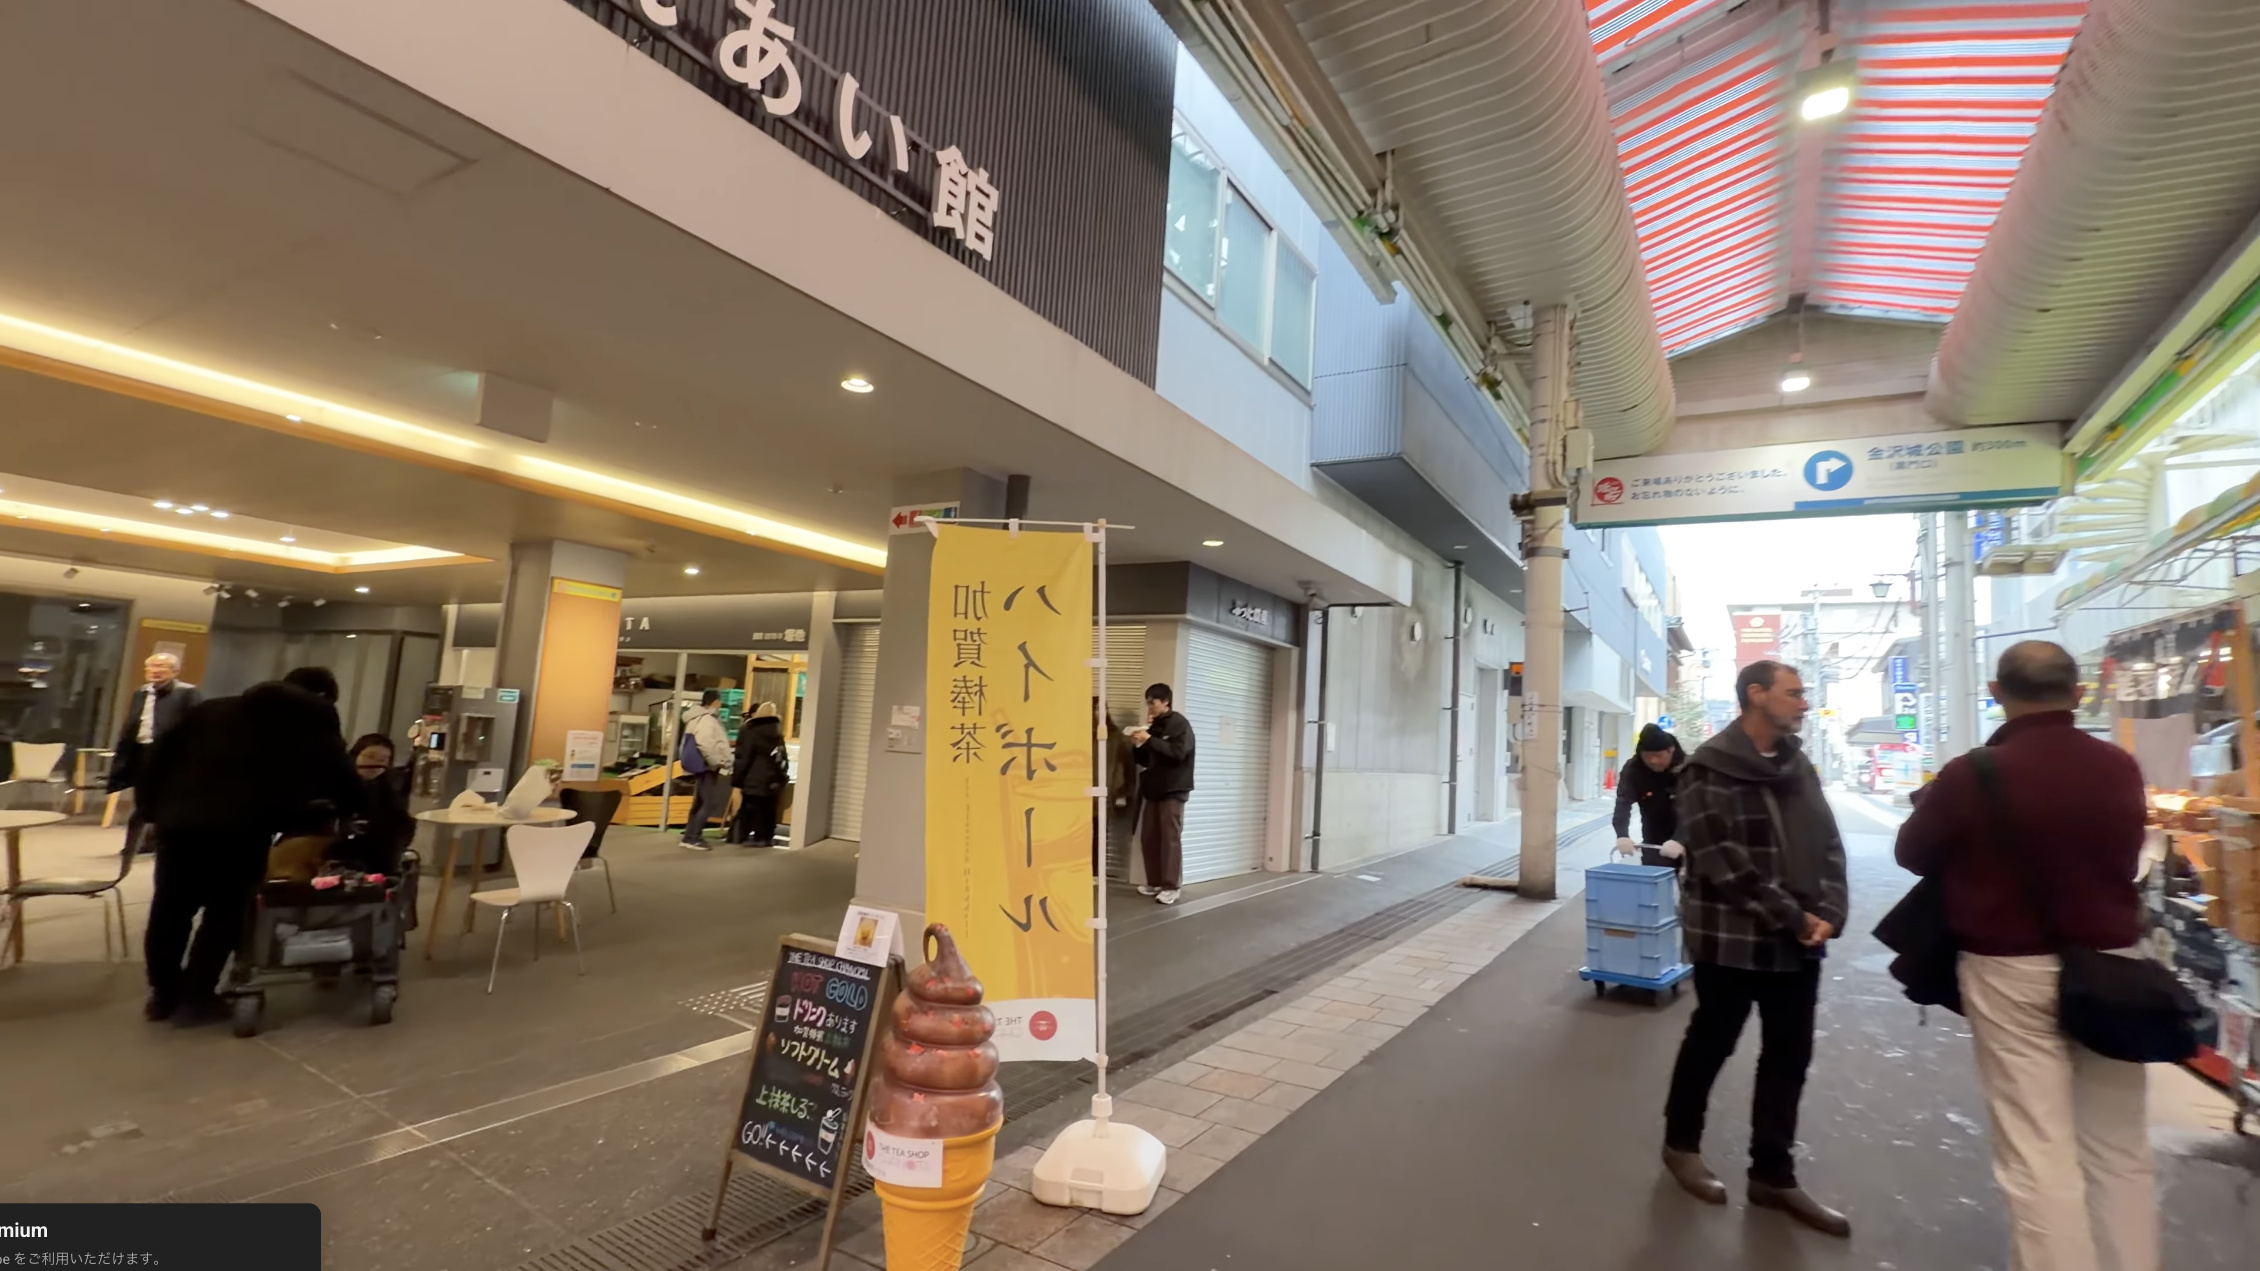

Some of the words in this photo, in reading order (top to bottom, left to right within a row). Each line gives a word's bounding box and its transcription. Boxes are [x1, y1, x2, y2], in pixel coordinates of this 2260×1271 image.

[1867, 440, 1964, 460] 金沢城公園
[781, 1037, 840, 1079] ソフトクリーム
[878, 1142, 890, 1155] THE
[892, 1147, 905, 1157] TEA
[907, 1150, 930, 1159] SHOP
